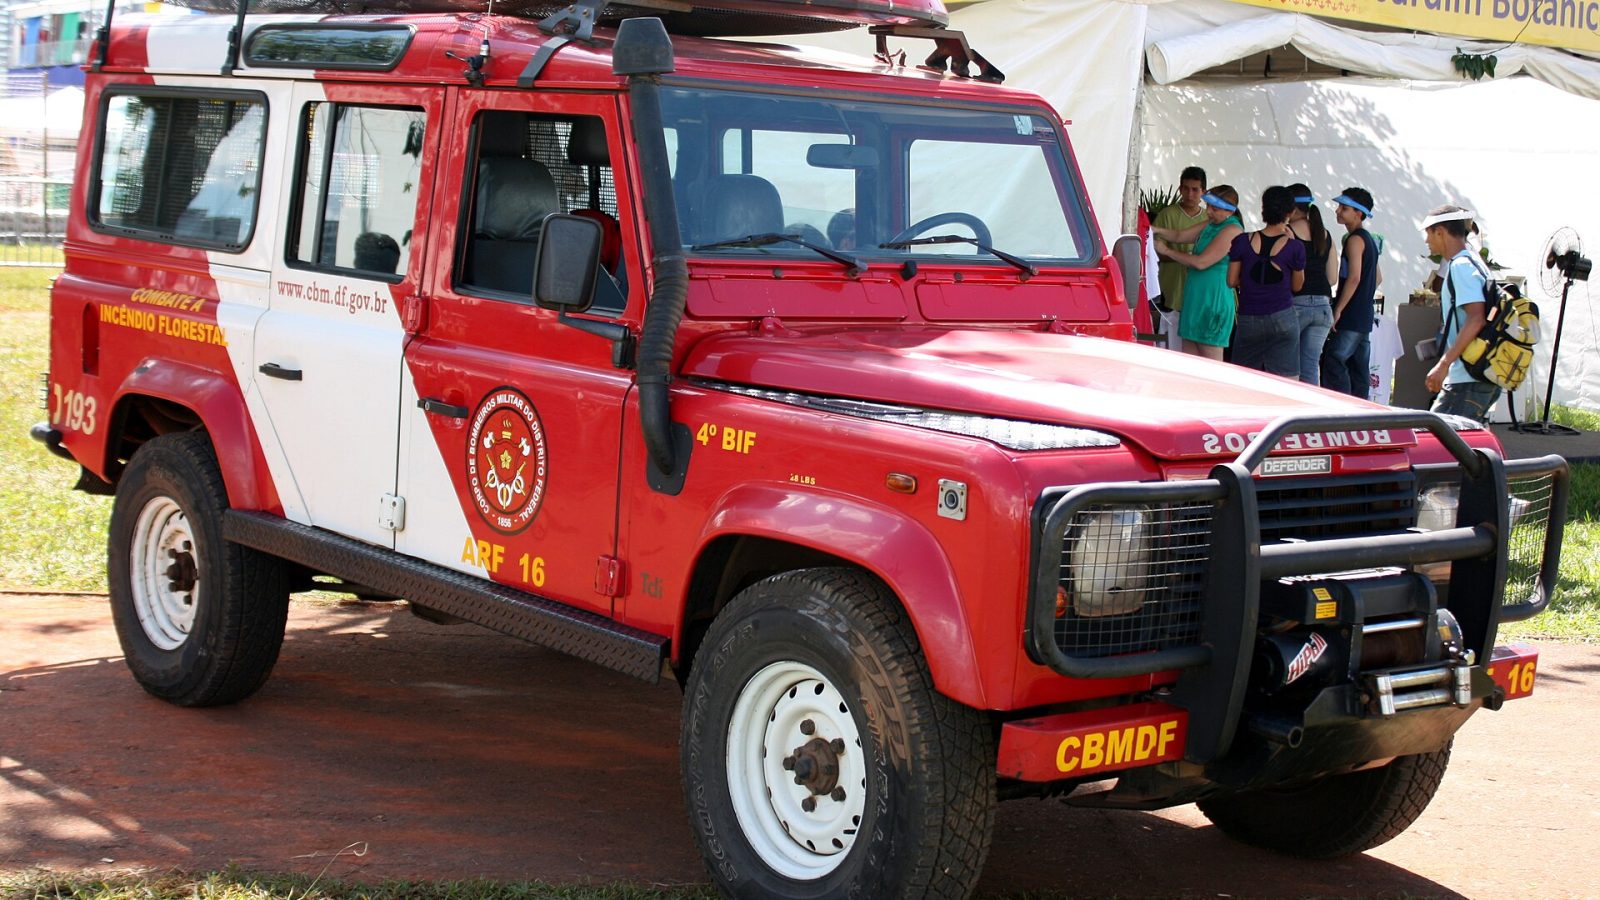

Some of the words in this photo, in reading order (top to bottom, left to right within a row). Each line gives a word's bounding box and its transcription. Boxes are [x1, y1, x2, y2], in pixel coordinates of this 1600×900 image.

[131, 288, 196, 311] COMBATE
[190, 299, 206, 312] A
[277, 281, 387, 314] www.cbm.df.gov.br
[100, 304, 156, 332] INCÊNDIO
[158, 315, 229, 347] FLORESTAL
[64, 389, 96, 435] 193
[496, 394, 524, 410] MILITAR
[523, 405, 534, 421] DO
[469, 398, 496, 455] BOMBEIROS
[722, 426, 757, 454] BIF
[531, 421, 545, 476] DISTRITO
[469, 458, 476, 474] DE
[800, 475, 816, 485] LBS
[1263, 458, 1328, 473] DEFENDER
[472, 477, 490, 514] CORPO
[519, 479, 543, 522] FEDERAL
[461, 537, 505, 574] ARF
[519, 553, 546, 588] 16
[1508, 661, 1535, 694] 16
[1055, 720, 1178, 773] CBMDF
